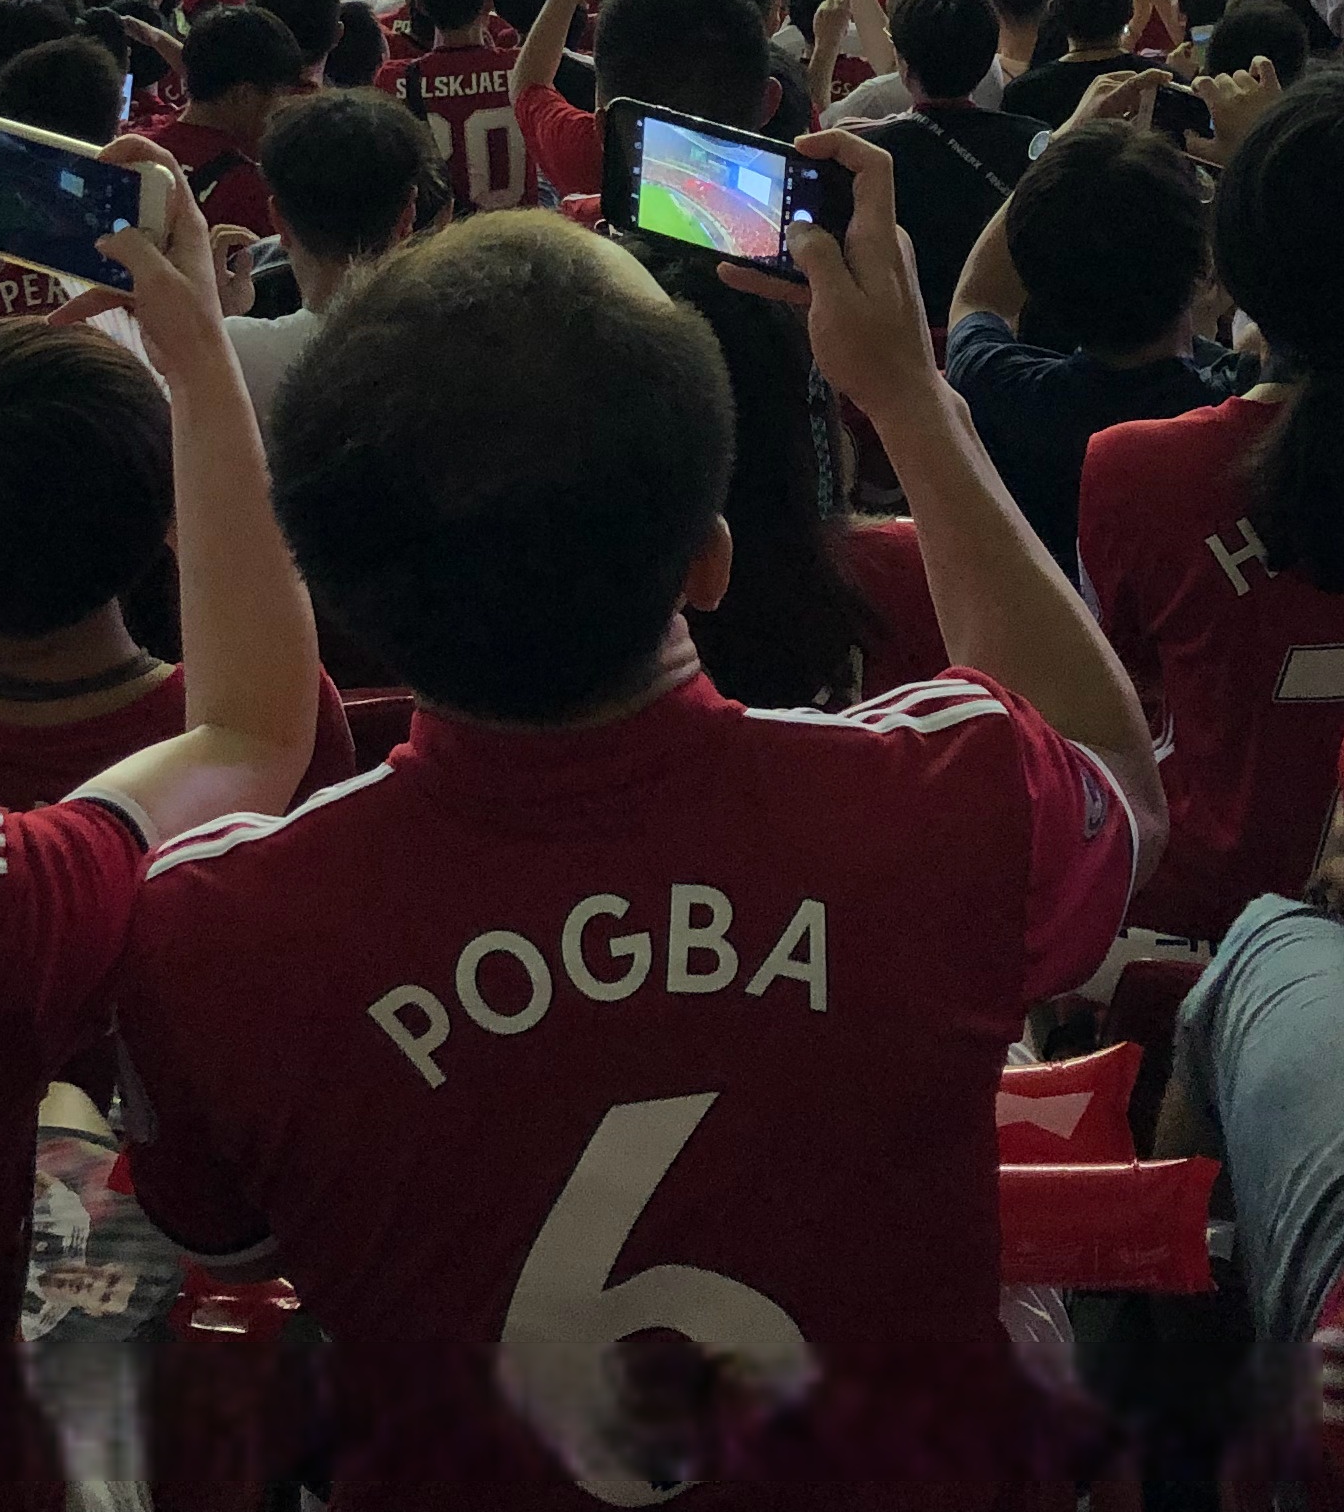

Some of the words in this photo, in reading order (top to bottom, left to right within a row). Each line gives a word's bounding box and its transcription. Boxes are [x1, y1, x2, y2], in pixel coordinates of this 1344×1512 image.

[395, 69, 513, 99] SLSKJAE
[368, 884, 831, 1086] POGBA
[497, 1092, 822, 1507] 6
